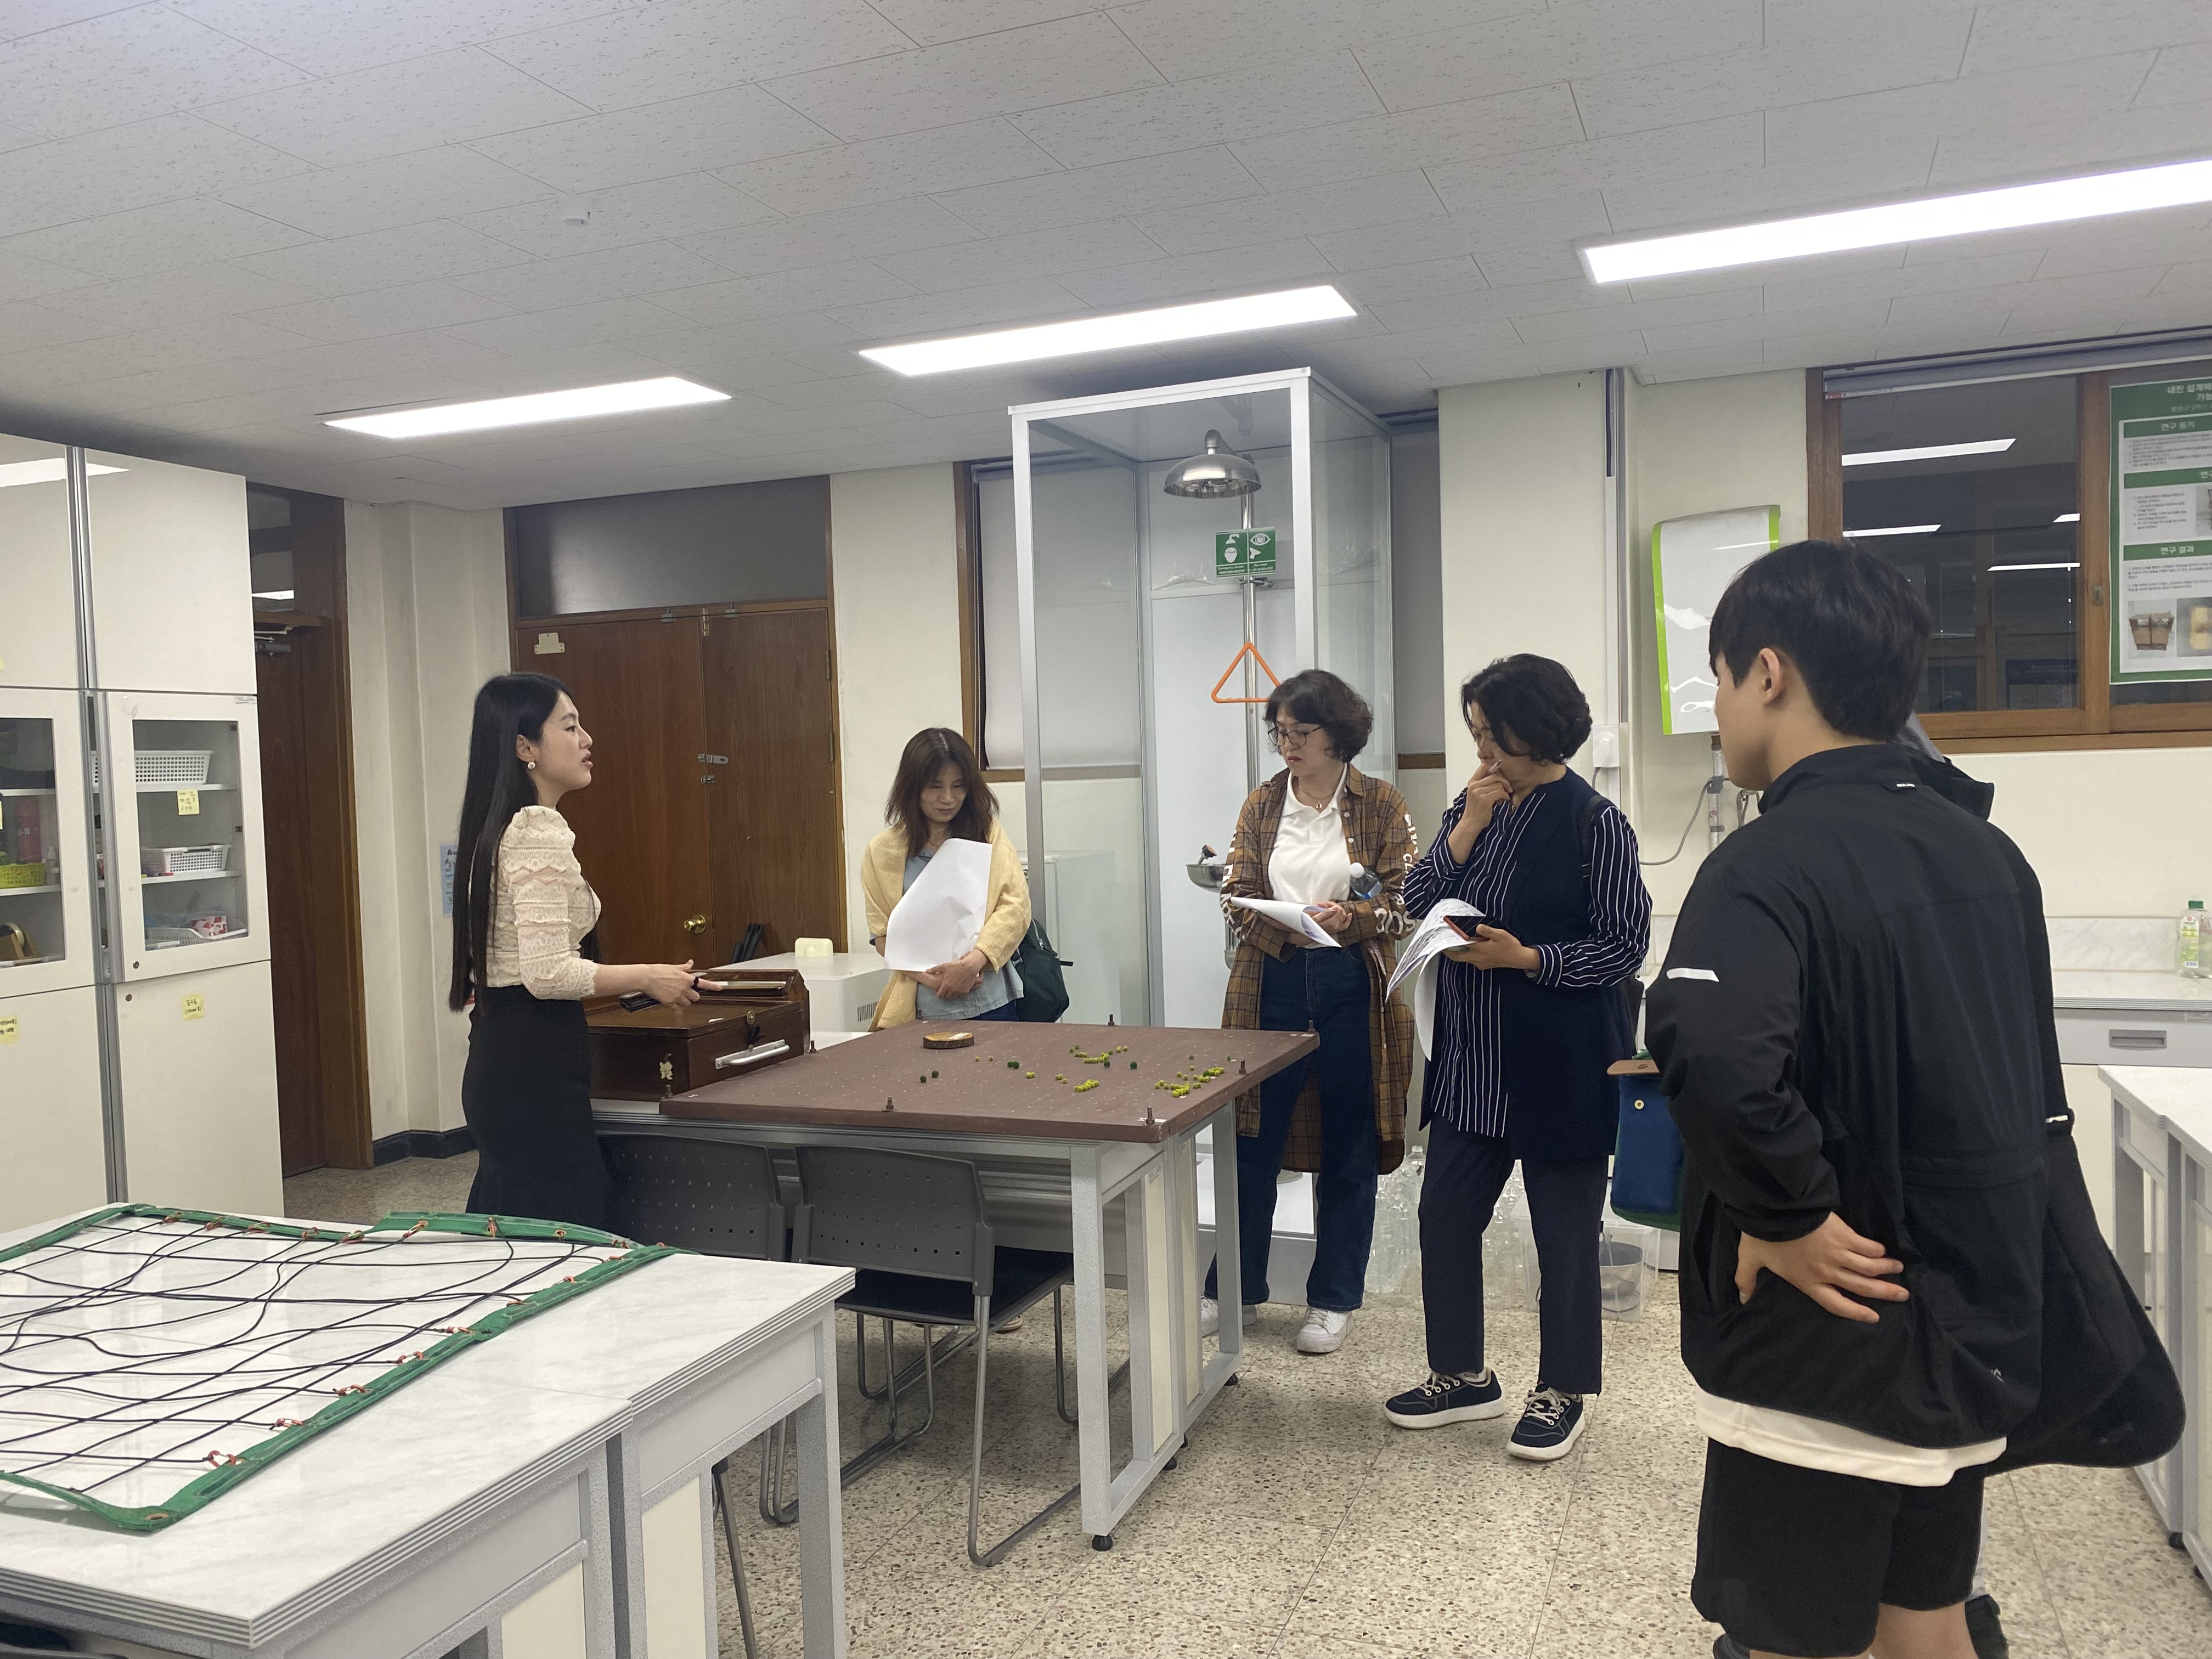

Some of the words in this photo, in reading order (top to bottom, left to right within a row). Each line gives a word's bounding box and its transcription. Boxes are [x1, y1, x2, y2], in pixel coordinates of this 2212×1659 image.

[2161, 422, 2177, 431] 연구
[2160, 546, 2177, 555] 연구
[2179, 545, 2194, 554] 결과
